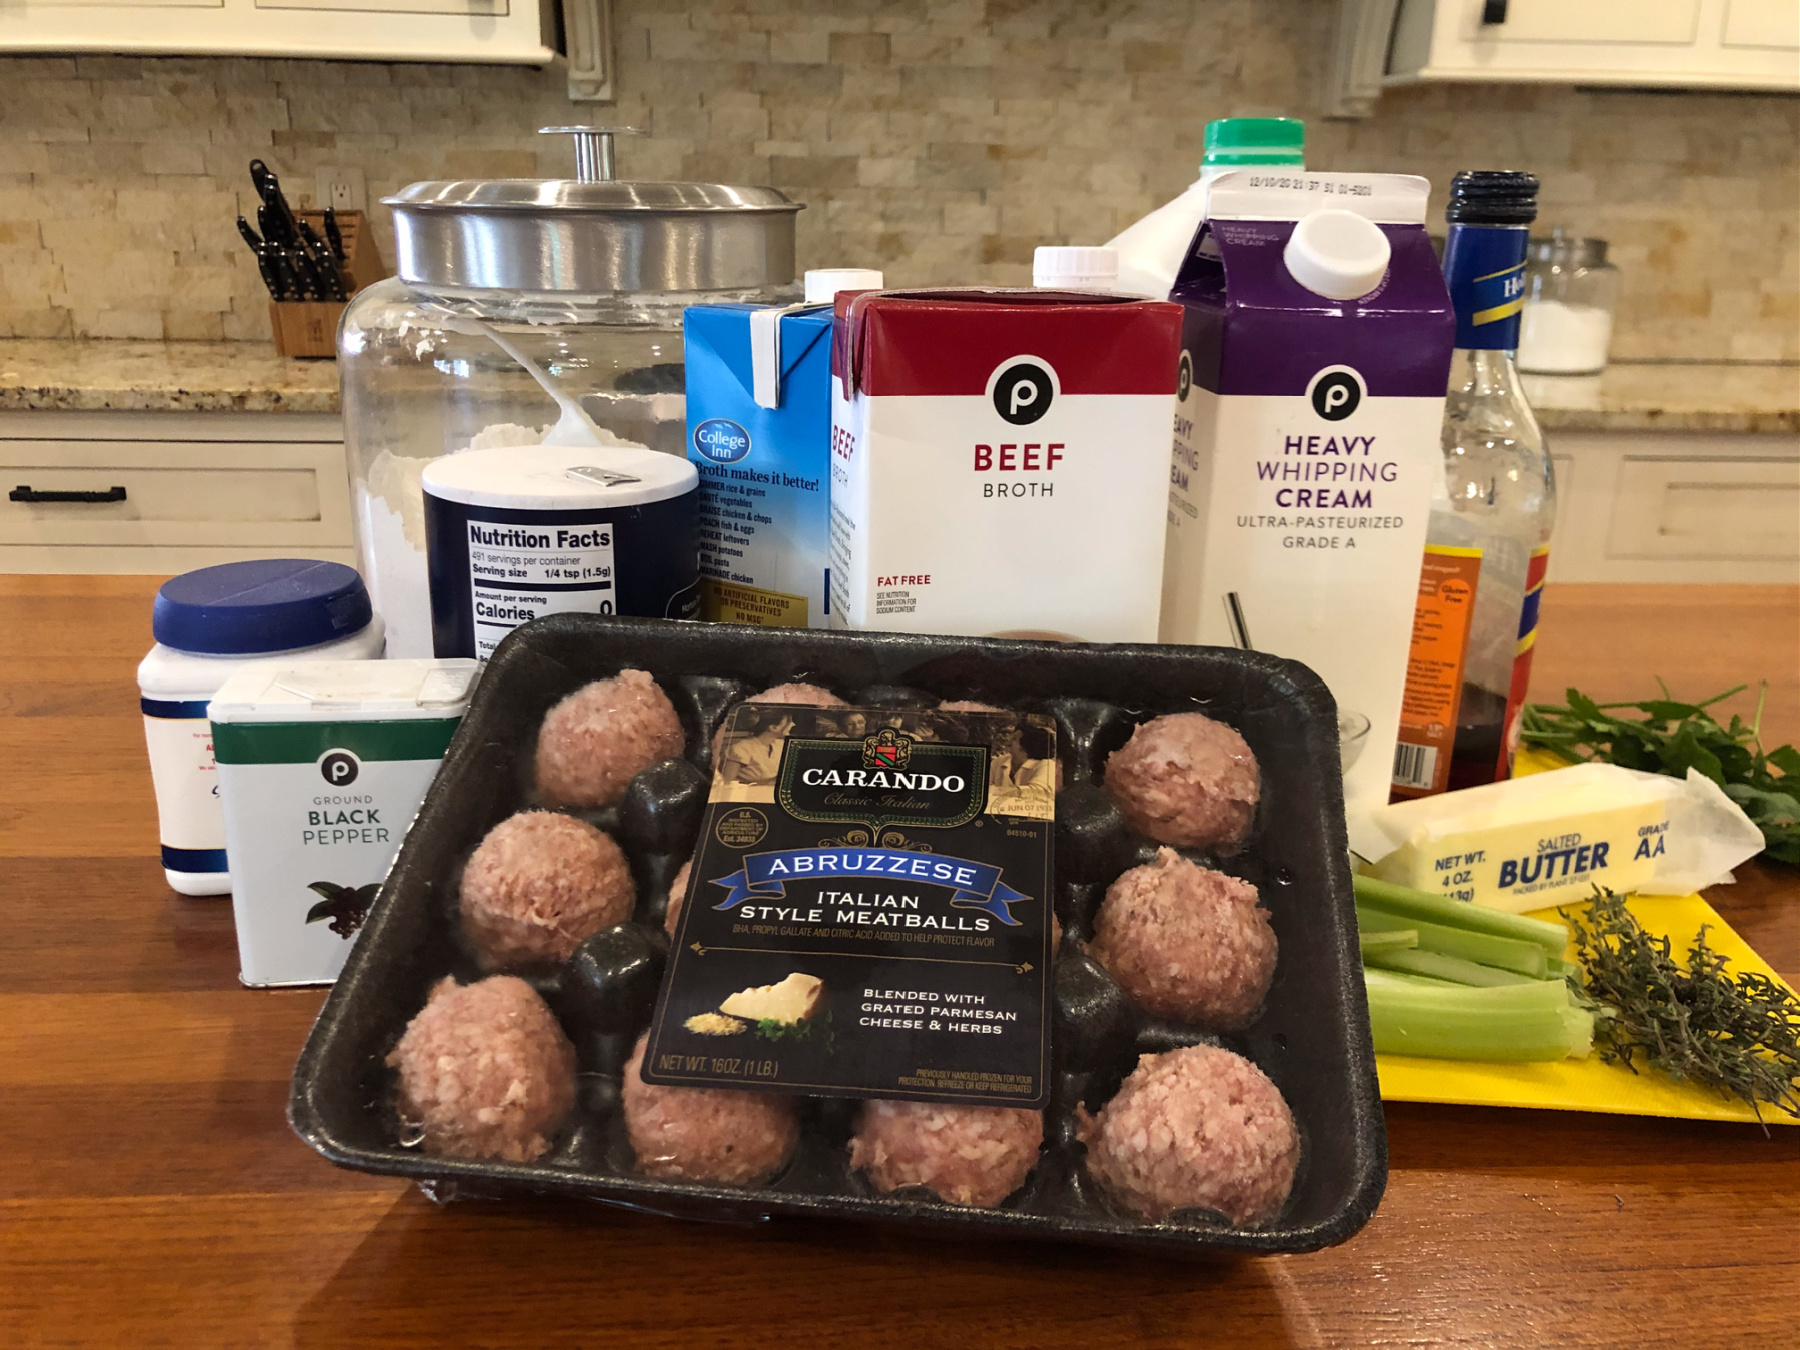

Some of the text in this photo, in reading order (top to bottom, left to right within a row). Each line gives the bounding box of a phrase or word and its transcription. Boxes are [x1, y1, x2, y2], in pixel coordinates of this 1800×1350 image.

[698, 429, 746, 450] College
[832, 424, 856, 462] BEEF
[1284, 435, 1376, 456] HEAVY
[711, 444, 732, 459] Inn
[974, 443, 1066, 471] BEEF
[695, 460, 820, 492] Broth makes it better!
[1256, 461, 1399, 482] WHIPPING
[725, 483, 738, 493] rice
[739, 485, 745, 495] &
[746, 487, 766, 497] grains
[983, 482, 1054, 498] BROTH
[1275, 488, 1373, 509] CREAM
[720, 497, 753, 509] vegetables
[700, 516, 755, 536] POACH fish & eggs
[722, 509, 746, 520] chicken
[747, 511, 753, 521] &
[753, 513, 773, 525] chops
[1236, 515, 1404, 529] ULTRA-PASTEURIZED
[470, 525, 610, 548] Nutrition Facts
[700, 529, 750, 546] REHEAT leftovers
[1282, 536, 1356, 549] GRADE A
[700, 541, 743, 558] MASH potatoes
[472, 551, 581, 567] 491 servings per container
[714, 558, 730, 568] pasta
[472, 563, 611, 580] Serving size 1/4 tsp (1.5g)
[700, 566, 754, 584] MARINADE chicken
[877, 574, 931, 587] FAT FREE
[474, 591, 547, 605] Amount per serving
[723, 588, 759, 603] ARTIFICIAL
[760, 597, 790, 609] FLAVORS
[475, 600, 613, 620] Calories 0
[730, 599, 782, 617] PRESERVATIVES
[736, 611, 745, 621] NO
[895, 605, 916, 613] CONTENT
[802, 769, 966, 793] CARANDO
[313, 795, 373, 806] GROUND
[823, 792, 932, 810] Classic Italian
[308, 809, 381, 826] BLACK
[302, 828, 390, 845] PEPPER
[1637, 820, 1670, 838] GRADE
[1537, 832, 1581, 853] SALTED
[1434, 849, 1486, 872] NET WT.
[1498, 841, 1610, 889] BUTTER
[767, 854, 978, 886] ABRUZZESE
[1441, 870, 1474, 887] 4 OZ.
[1539, 882, 1548, 892] BY
[817, 891, 920, 909] ITALIAN
[740, 905, 991, 932] STYLE MEATBALLS
[732, 923, 996, 947] BHA, PROPYL GALLATE AND CITRIC ACID ADDED TO HELP PROTECT FLAVOR
[863, 988, 985, 1005] BLENDED WITH
[861, 1002, 1017, 1022] GRATED PARMESAN
[859, 1017, 1003, 1035] CHEESE & HERBS
[659, 1054, 684, 1071] NET
[685, 1055, 708, 1073] WT.
[743, 1059, 755, 1077] (1
[756, 1060, 779, 1079] LB.)
[916, 1068, 1032, 1084] PREVIOUSLY HANDLED FROZEN FOR YOUR
[937, 1079, 965, 1089] REFREEZE
[965, 1081, 975, 1089] OR
[975, 1082, 990, 1091] KEEP
[990, 1082, 1032, 1094] REFRIGERATED
